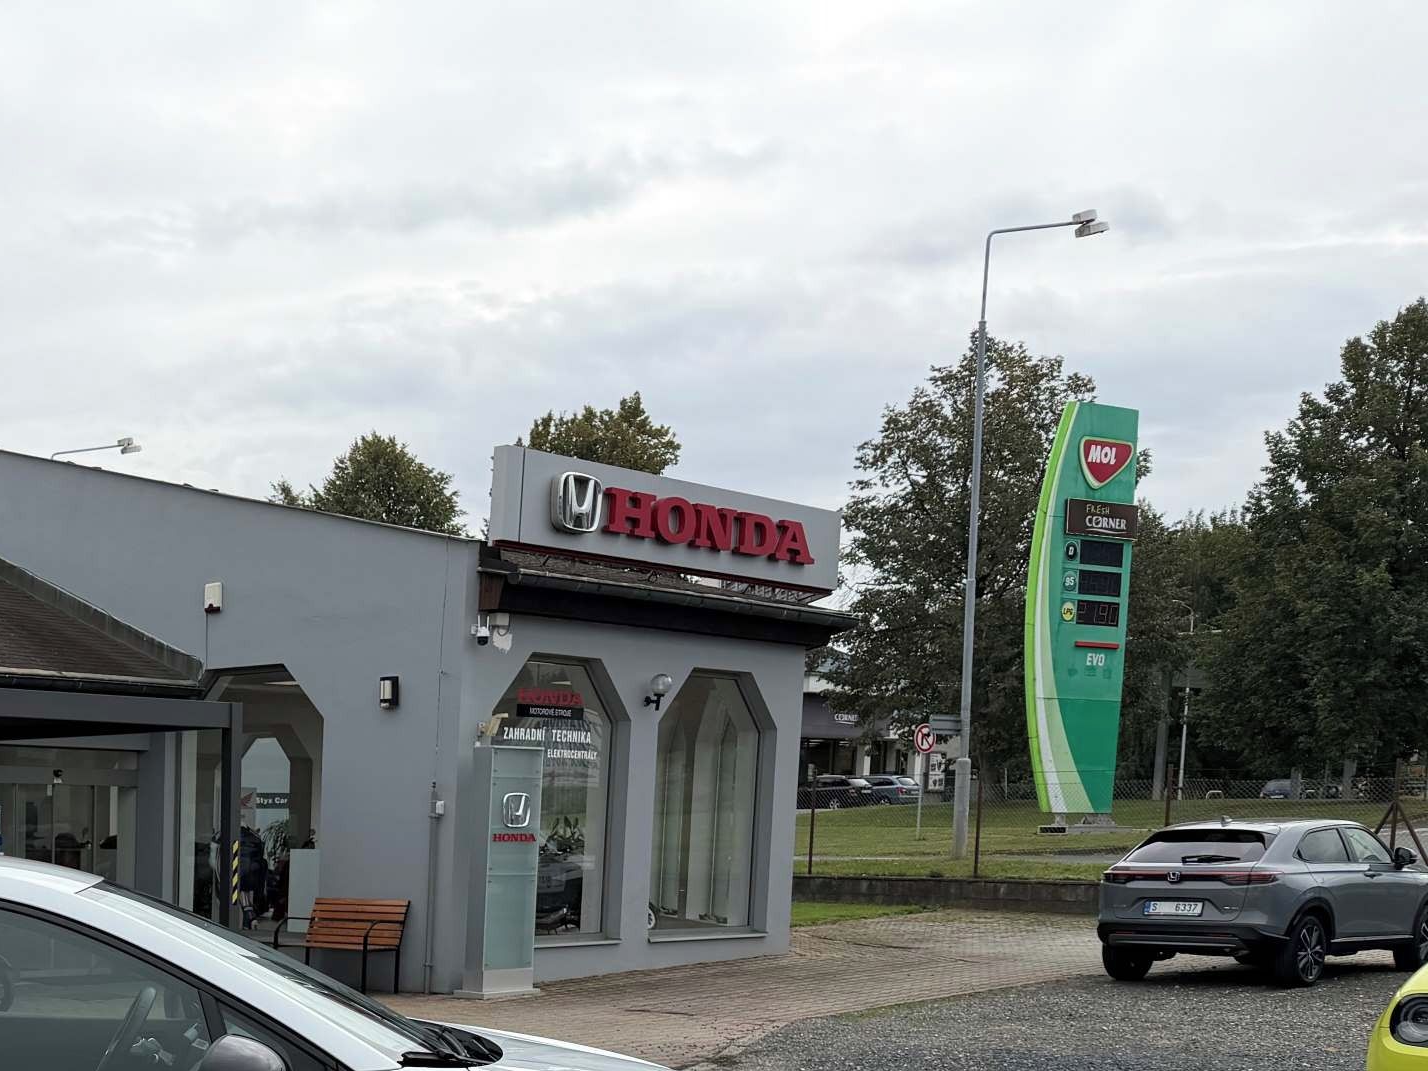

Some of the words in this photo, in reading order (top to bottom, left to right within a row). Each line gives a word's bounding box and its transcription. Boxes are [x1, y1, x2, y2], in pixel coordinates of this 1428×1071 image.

[1087, 444, 1117, 464] MOL
[1086, 504, 1110, 515] FRESH
[602, 487, 815, 565] HONDA
[1085, 515, 1127, 530] CORNER
[1068, 546, 1074, 555] D
[1065, 576, 1075, 587] 95
[1086, 653, 1105, 667] EVO
[503, 726, 546, 741] ZAHRADNÍ
[552, 729, 591, 744] TECHNIKA
[547, 748, 598, 759] ELEKTROCENTRÁLY
[492, 833, 537, 842] HONDA
[1175, 903, 1198, 912] 6337
